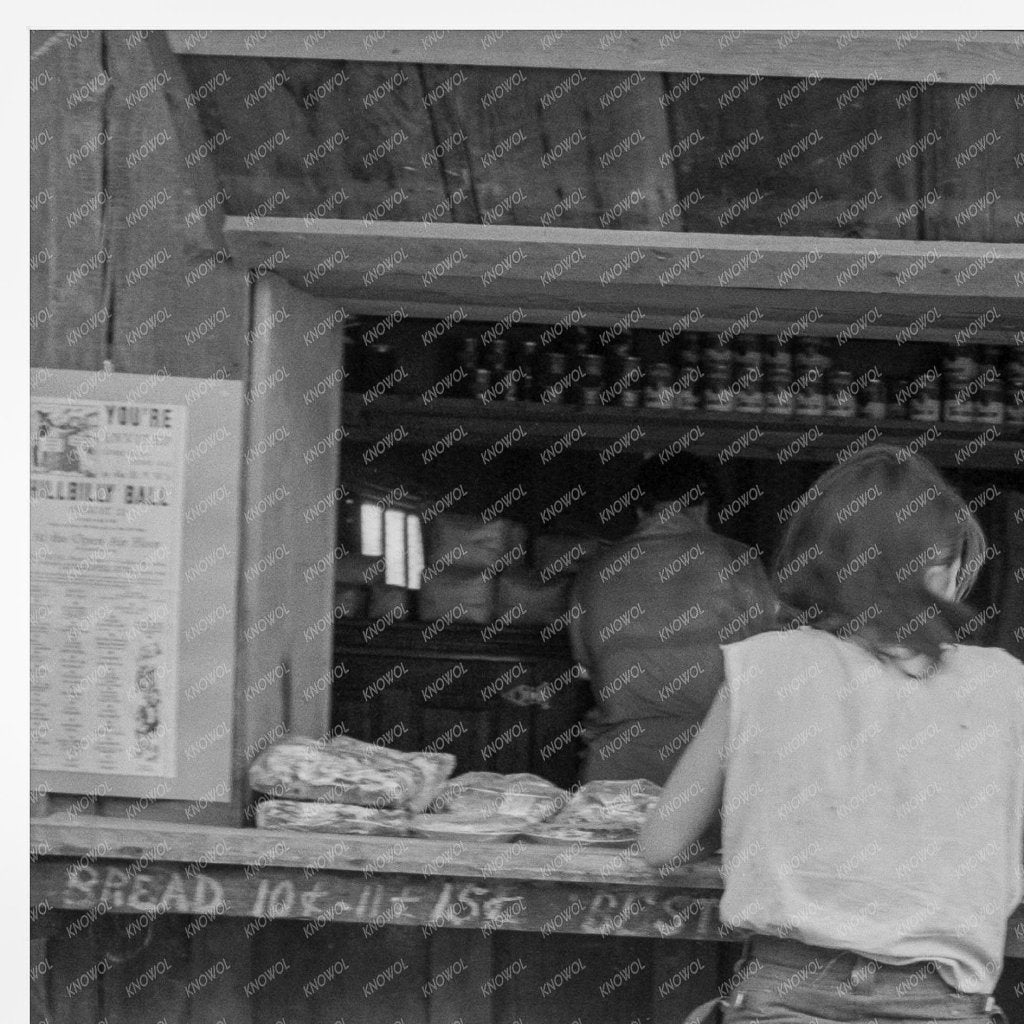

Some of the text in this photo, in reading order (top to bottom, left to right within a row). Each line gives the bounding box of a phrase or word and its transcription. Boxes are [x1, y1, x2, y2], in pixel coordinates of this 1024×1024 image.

[105, 405, 173, 428] YOU'RE
[124, 485, 169, 507] BALL
[62, 865, 224, 913] BREAD
